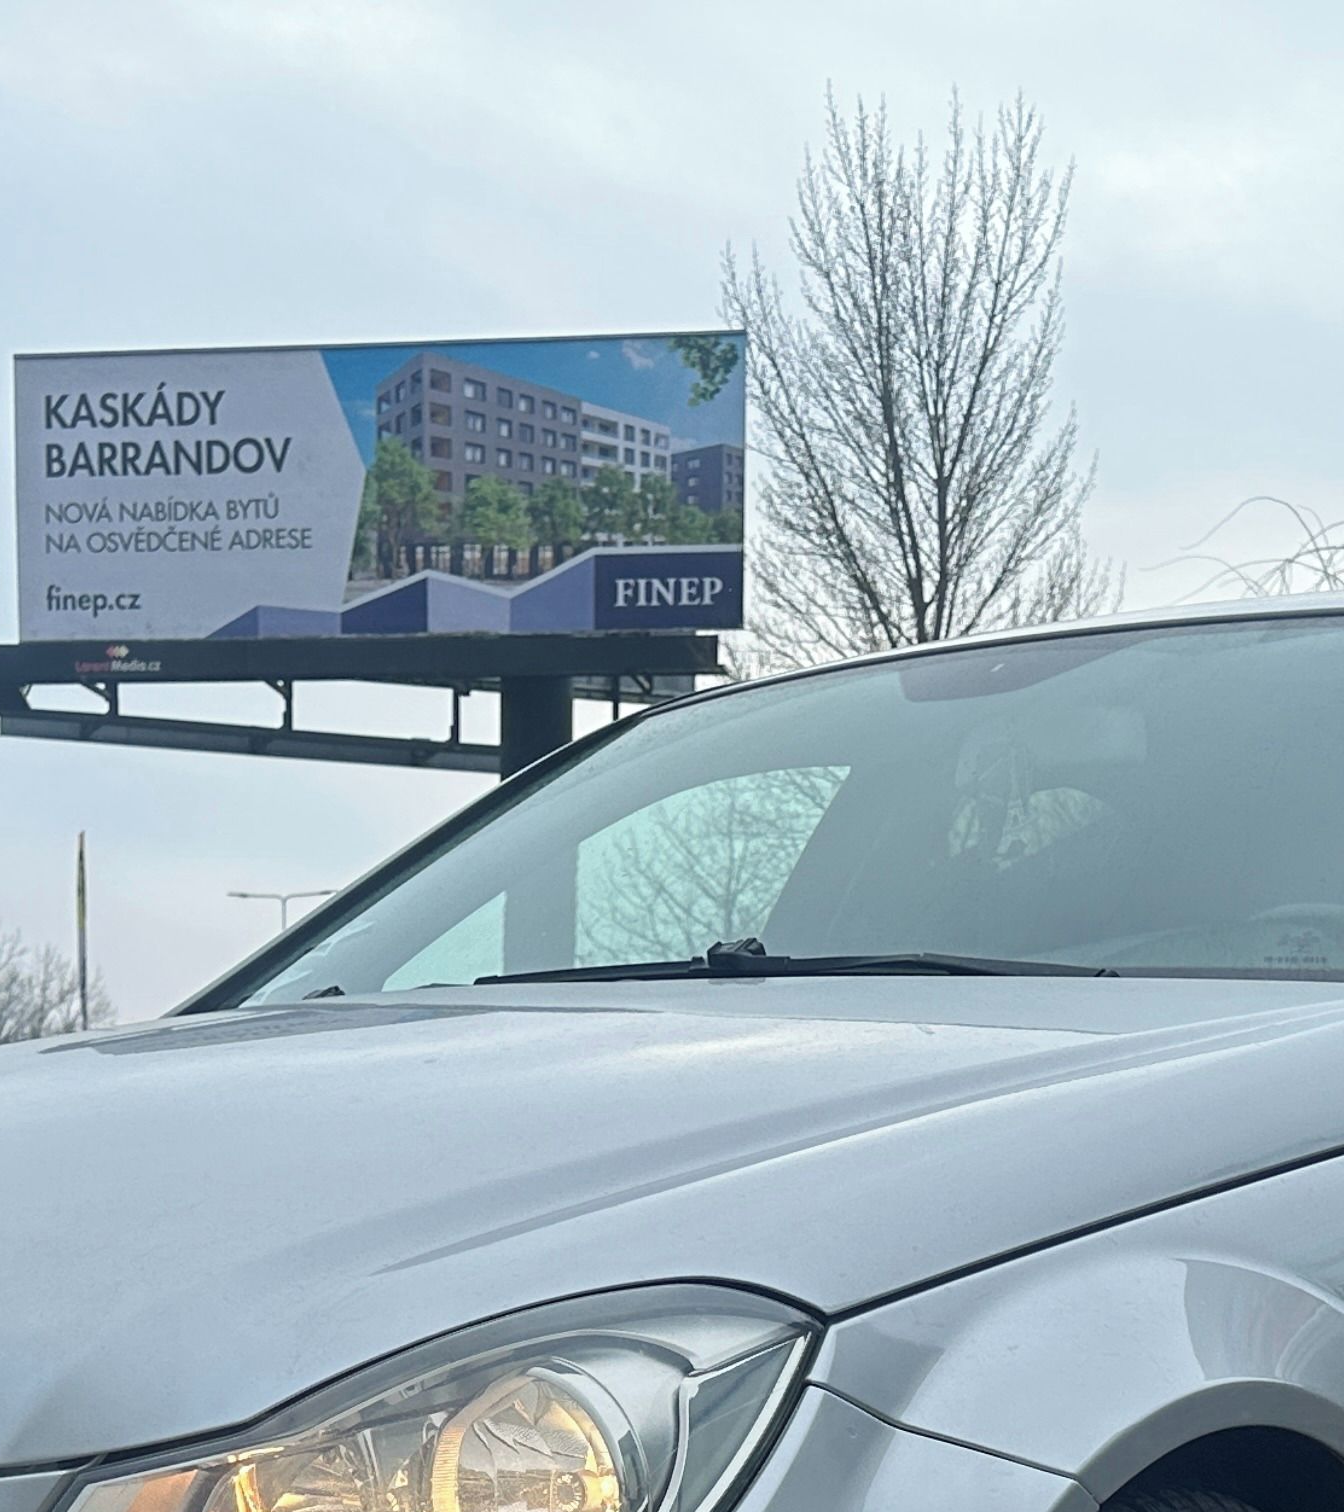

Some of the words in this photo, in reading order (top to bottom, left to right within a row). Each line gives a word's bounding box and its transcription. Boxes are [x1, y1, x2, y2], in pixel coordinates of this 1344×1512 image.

[44, 381, 226, 429] KASKÁDY
[45, 437, 292, 478] BARRANDOV
[45, 496, 113, 524] NOVÁ
[119, 496, 220, 523] NABÍDKA
[226, 492, 280, 521] BYTŮ
[45, 533, 81, 554] NA
[86, 525, 223, 554] OSVĚDČENÉ
[228, 528, 313, 551] ADRESE
[47, 584, 142, 618] finep.cz
[614, 577, 724, 607] FINEP
